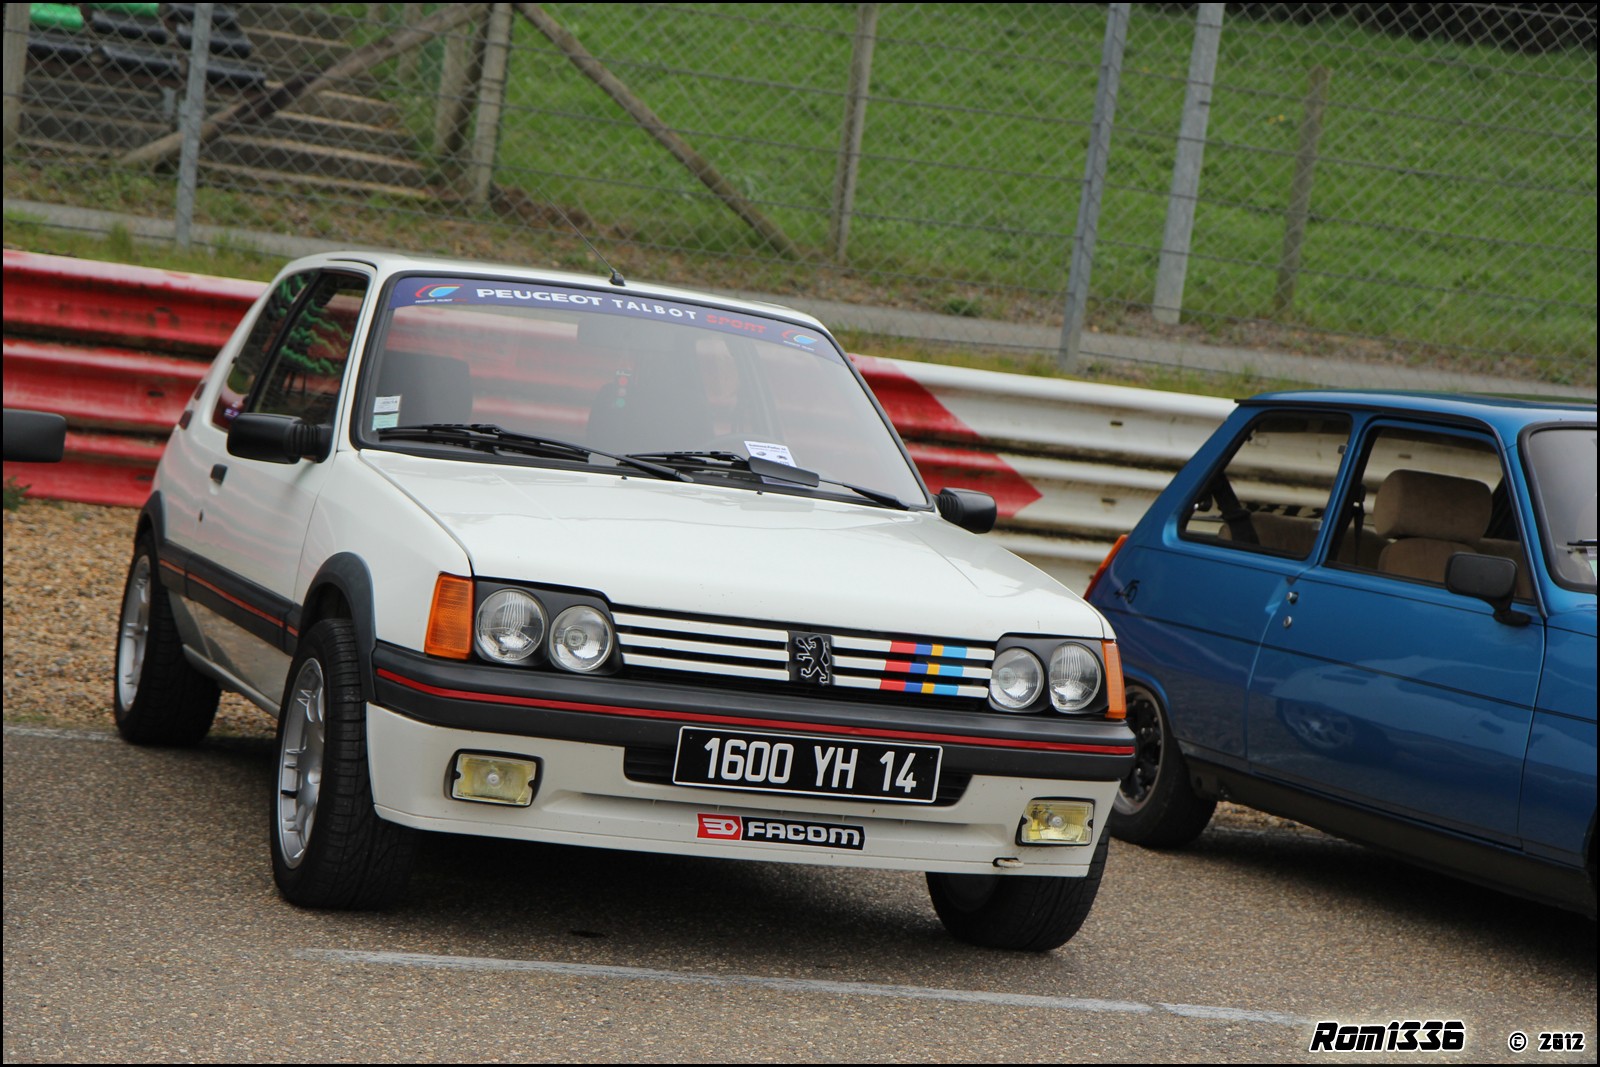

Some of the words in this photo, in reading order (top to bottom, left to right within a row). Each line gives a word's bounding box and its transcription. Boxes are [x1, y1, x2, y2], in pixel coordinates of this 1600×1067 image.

[476, 288, 603, 306] PEUGEOT
[612, 298, 697, 320] TALBOT
[705, 314, 767, 333] SPORT
[704, 737, 794, 784] 1600
[814, 745, 859, 789] YH
[879, 751, 917, 793] 14
[747, 821, 860, 846] FACOM
